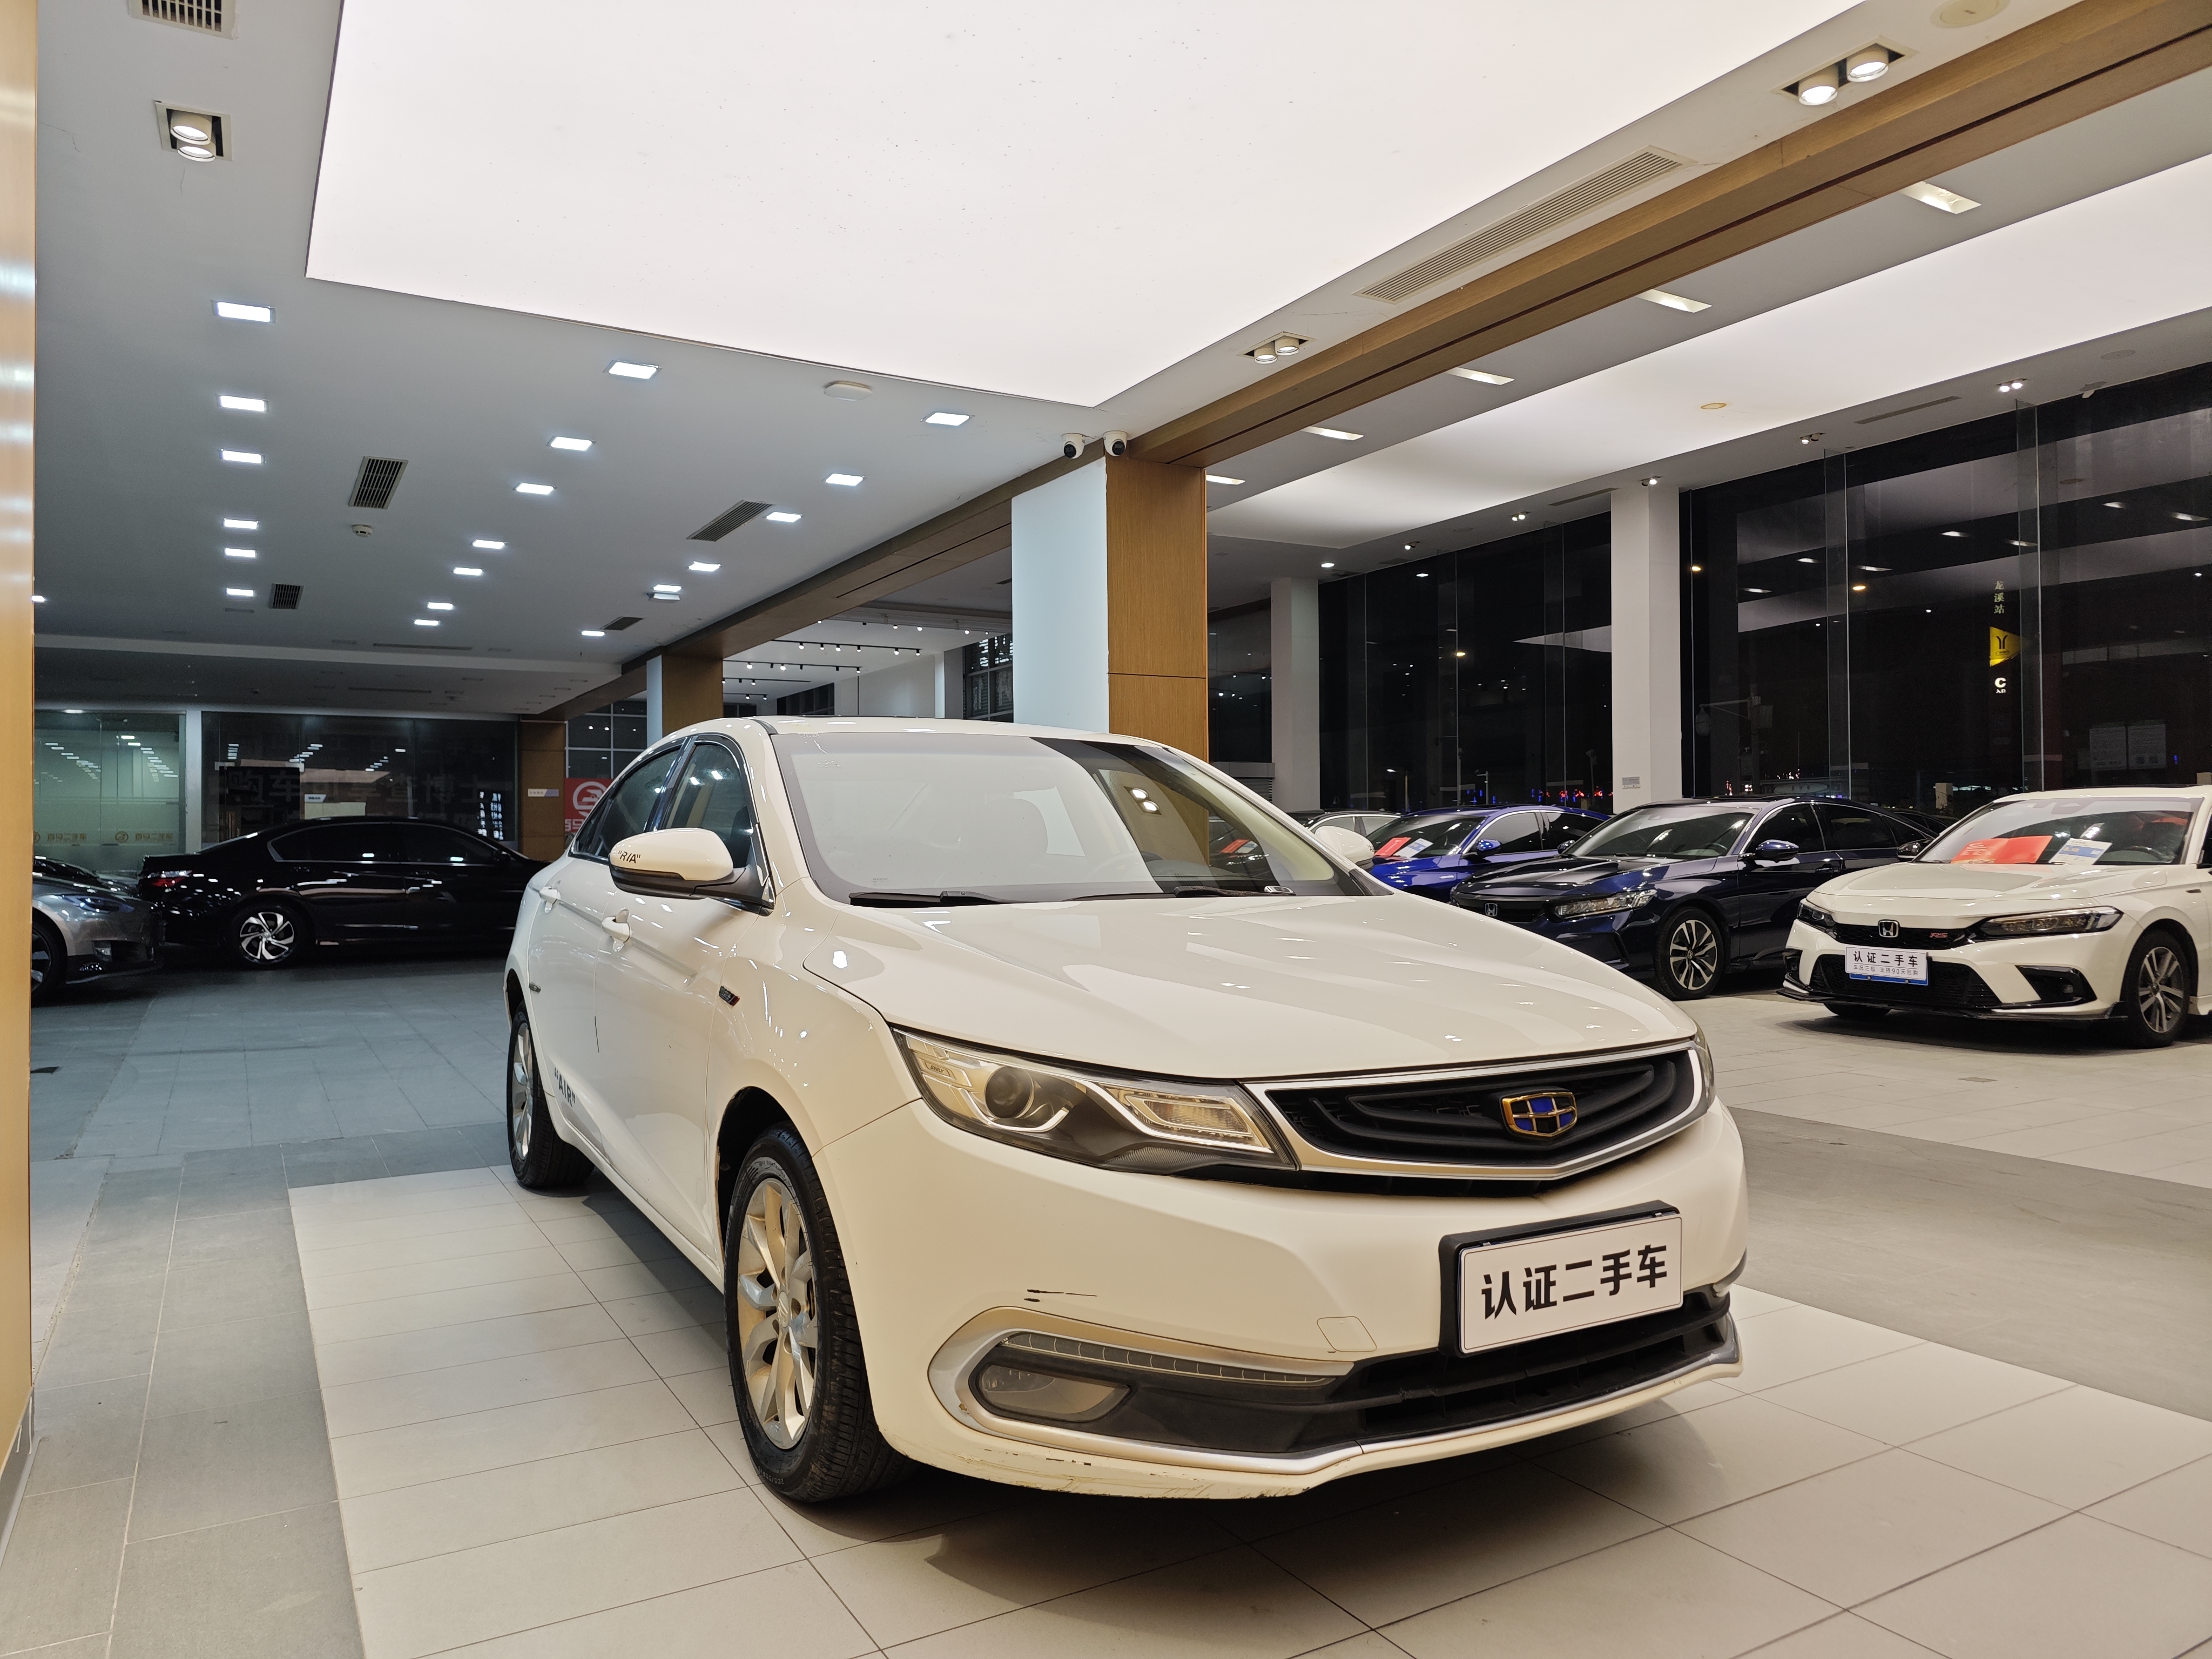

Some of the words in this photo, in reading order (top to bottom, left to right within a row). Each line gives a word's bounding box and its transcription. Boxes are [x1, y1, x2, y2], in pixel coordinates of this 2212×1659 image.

[1994, 581, 2005, 614] 龙溪站
[1995, 677, 2006, 688] C
[1853, 950, 1918, 967] 认证二手车
[930, 1065, 945, 1073] GEELY
[1481, 1244, 1668, 1320] 认证二手车
